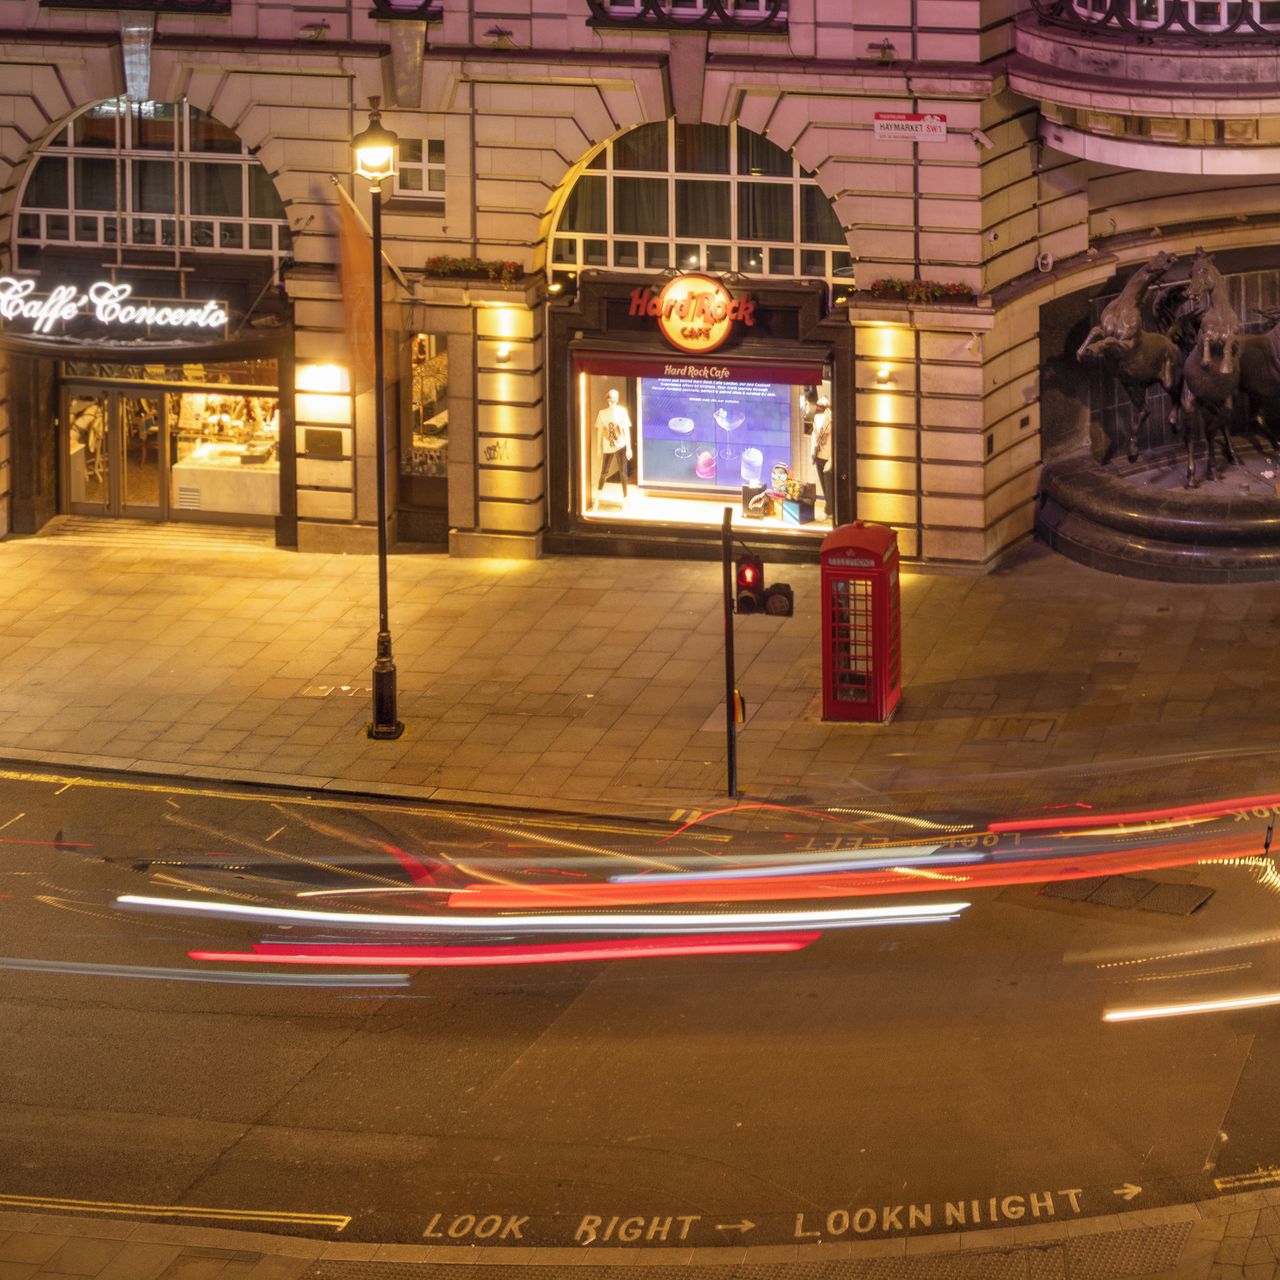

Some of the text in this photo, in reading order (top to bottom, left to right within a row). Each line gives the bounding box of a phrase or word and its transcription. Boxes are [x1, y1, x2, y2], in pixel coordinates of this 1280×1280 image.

[879, 123, 942, 133] HAYMARKET SW1
[89, 282, 229, 328] Concerto
[628, 288, 757, 327] Hard Rock
[664, 365, 730, 379] Hard Rock Cafe
[423, 1213, 701, 1241] LOOK RIGHT
